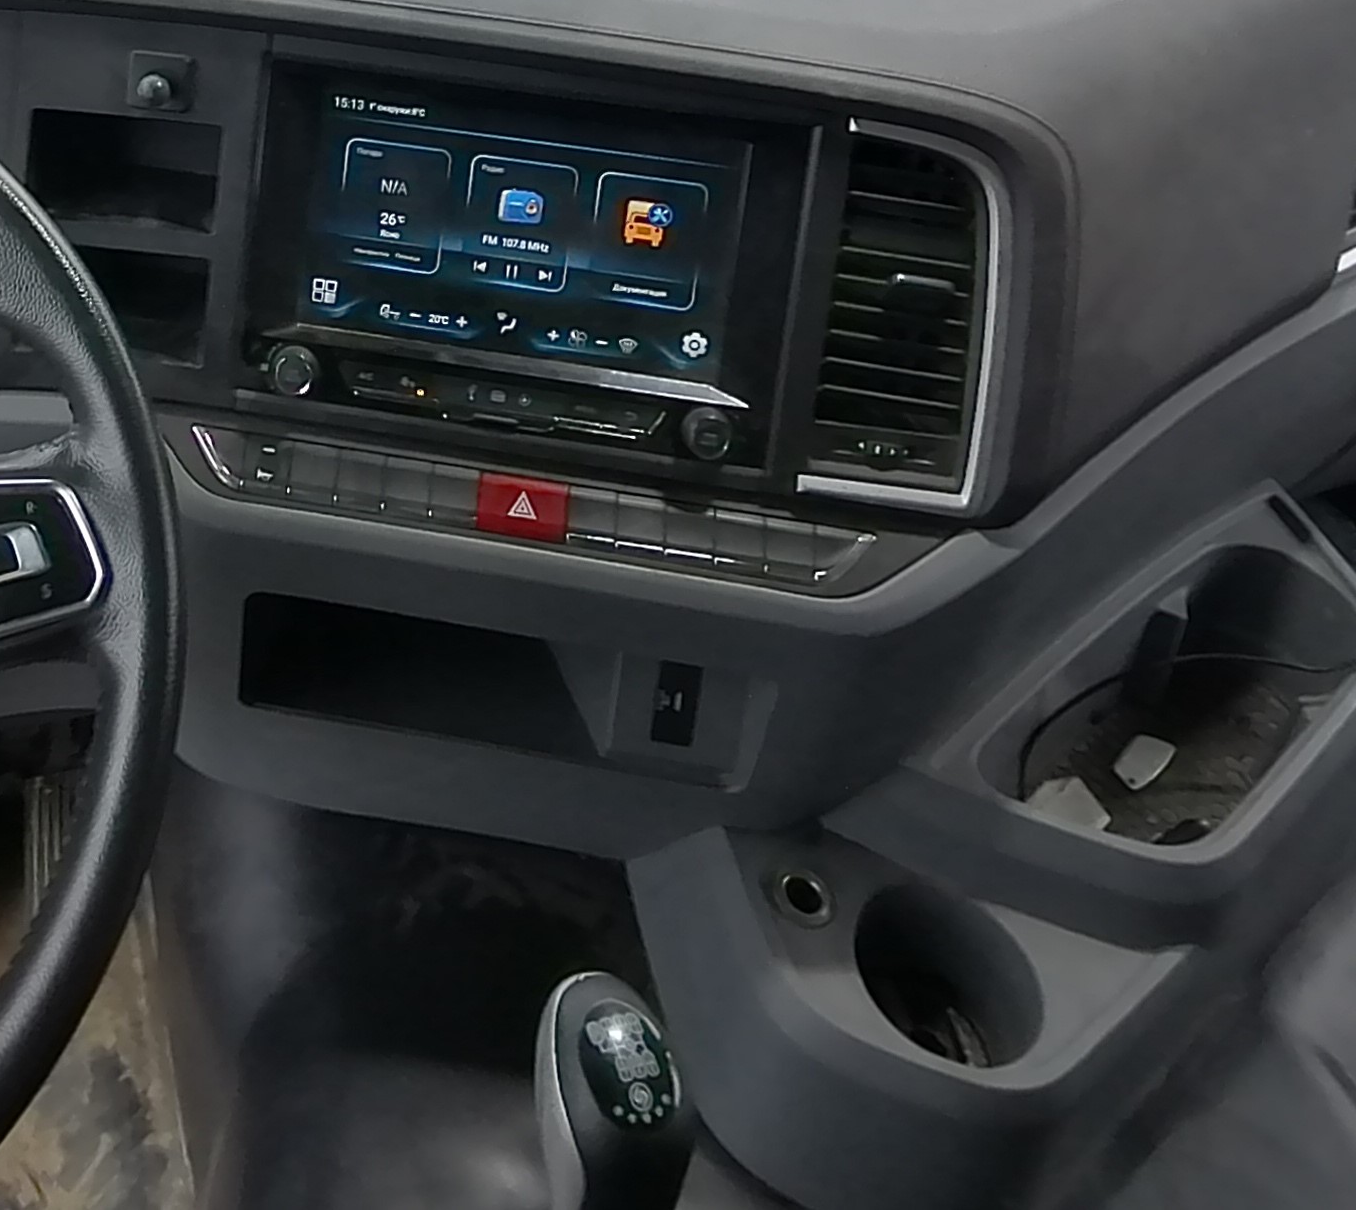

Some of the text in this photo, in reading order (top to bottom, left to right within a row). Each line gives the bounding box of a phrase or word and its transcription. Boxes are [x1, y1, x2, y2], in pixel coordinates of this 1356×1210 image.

[334, 96, 365, 111] 15:13
[380, 179, 408, 195] N/A
[482, 234, 498, 246] FM
[527, 241, 550, 254] MHz
